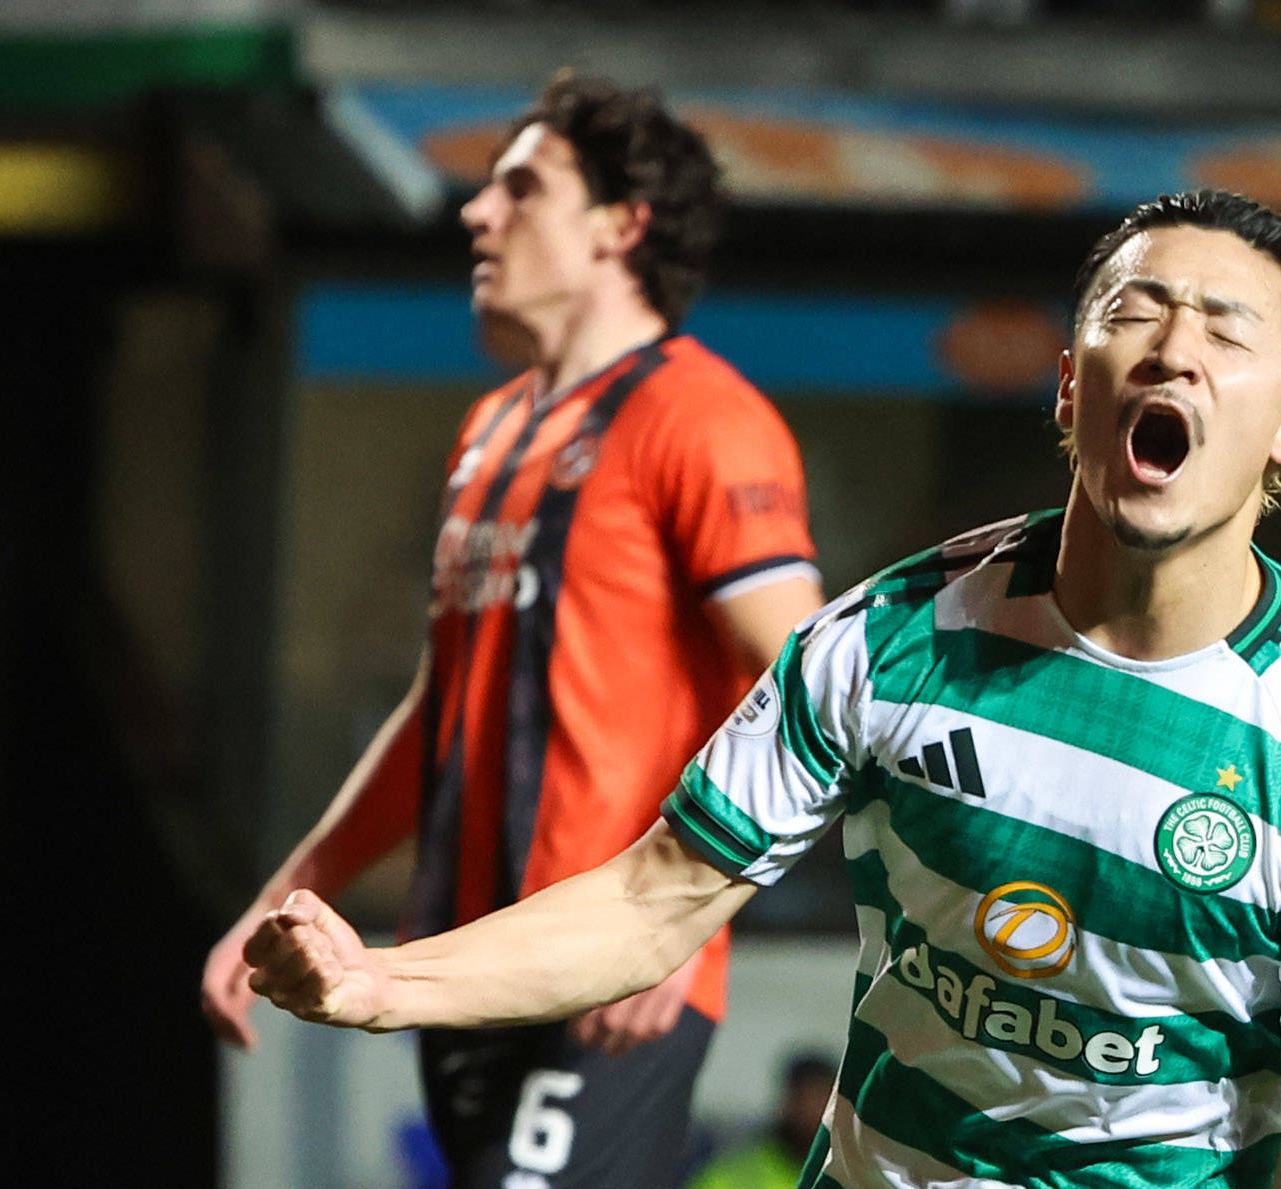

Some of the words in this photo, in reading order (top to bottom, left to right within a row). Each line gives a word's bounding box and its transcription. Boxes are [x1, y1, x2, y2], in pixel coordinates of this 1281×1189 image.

[1163, 814, 1180, 831] THE
[1176, 799, 1207, 817] CELTIC
[1208, 799, 1247, 833] FOOTBALL
[1239, 833, 1251, 859] CLUB
[900, 942, 1165, 1077] dafabet
[509, 1068, 585, 1174] 6
